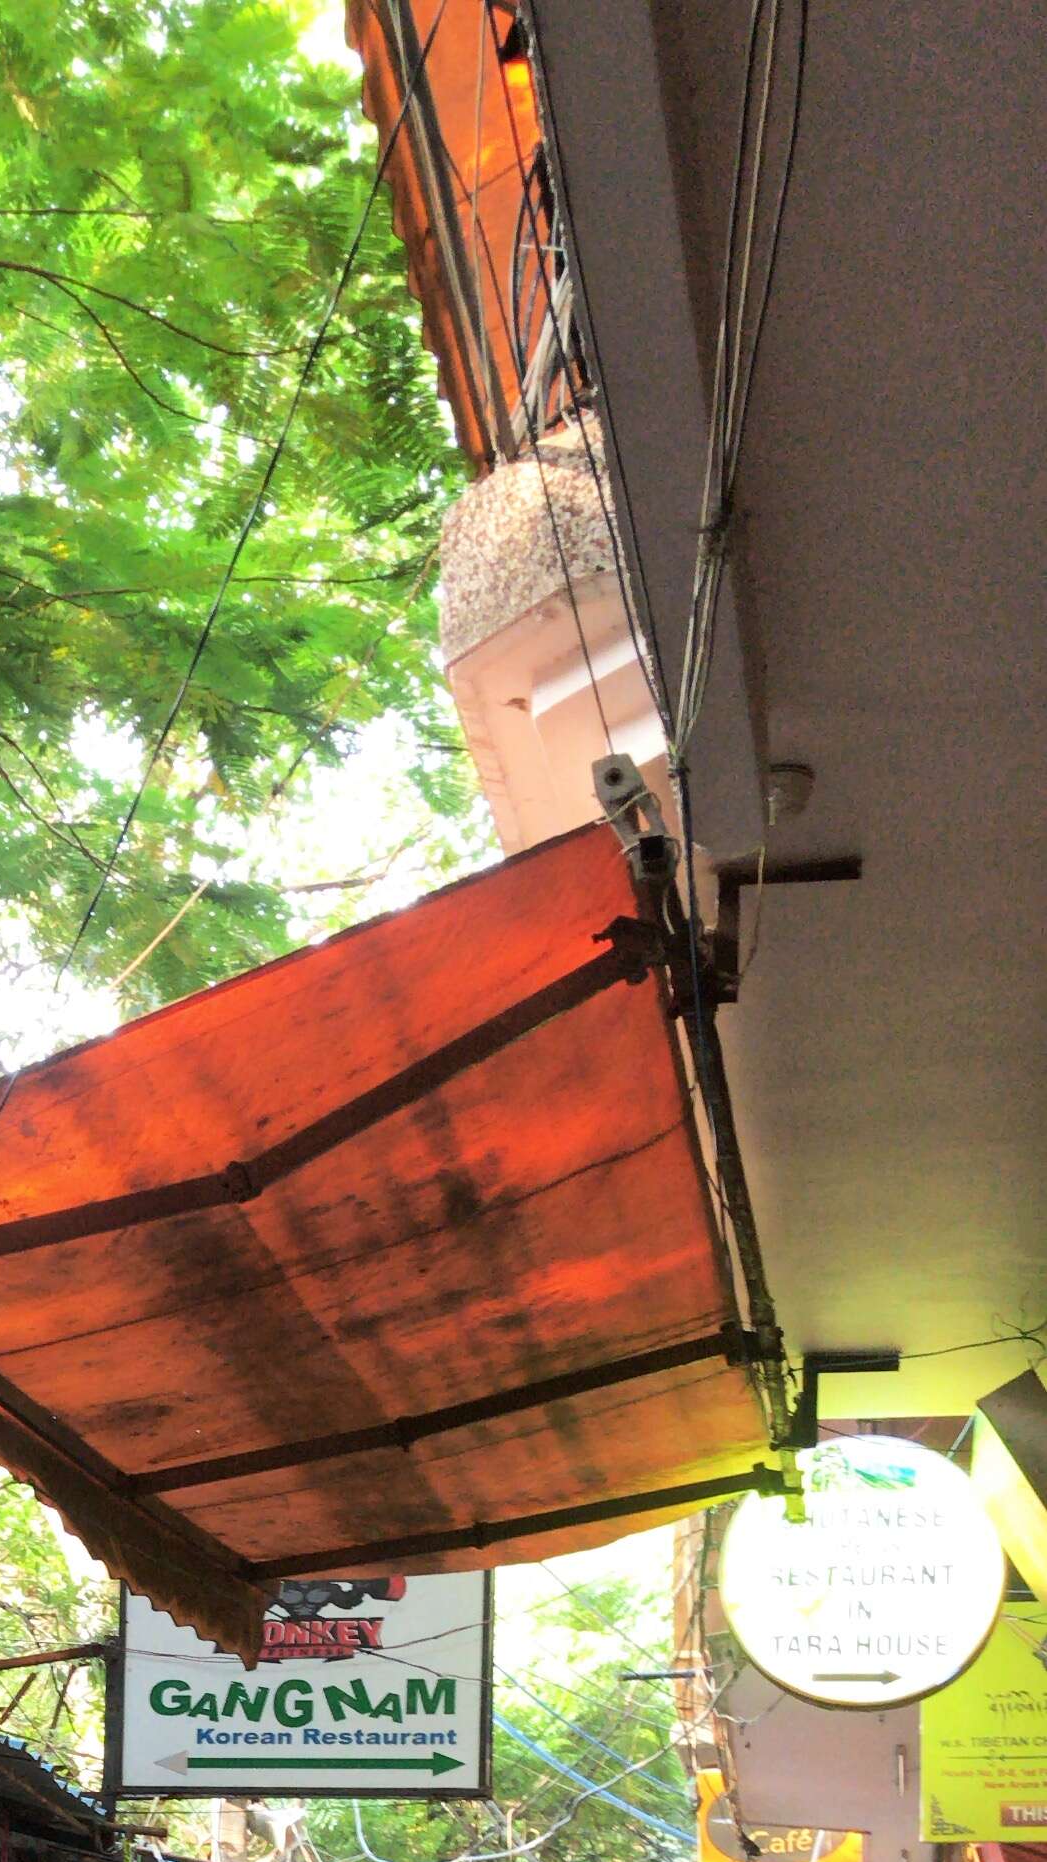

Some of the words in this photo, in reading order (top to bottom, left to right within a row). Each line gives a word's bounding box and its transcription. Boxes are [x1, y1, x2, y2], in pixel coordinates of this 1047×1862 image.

[782, 1507, 946, 1528] HUTANESE
[771, 1564, 954, 1586] RESTAURANT
[848, 1600, 872, 1620] IN
[263, 1620, 384, 1647] ONKEY
[773, 1634, 842, 1655] TARA
[856, 1634, 948, 1656] HOUSE
[196, 1728, 293, 1745] Korean
[303, 1728, 457, 1746] Restaurant
[971, 1736, 1029, 1748] TIBETAN
[749, 1828, 814, 1854] Café
